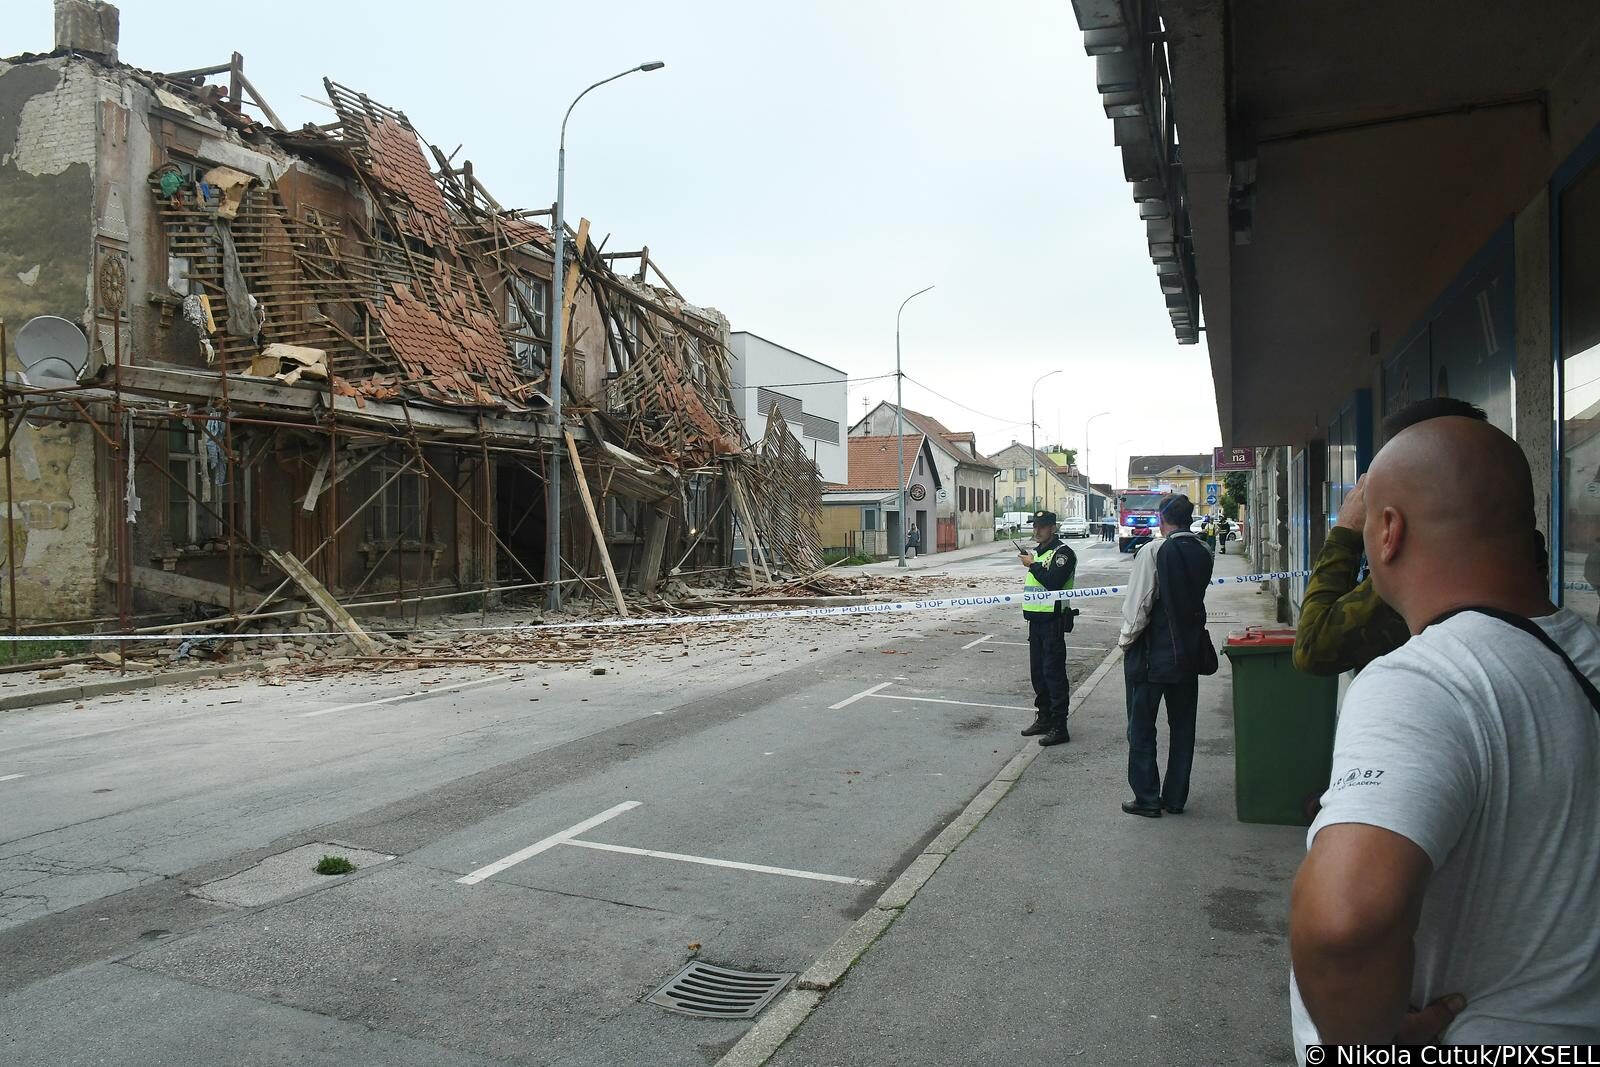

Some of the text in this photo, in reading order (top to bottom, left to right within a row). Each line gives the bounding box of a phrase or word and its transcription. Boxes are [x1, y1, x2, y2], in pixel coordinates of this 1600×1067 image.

[1236, 574, 1264, 583] STOP
[1024, 588, 1107, 601] STOP POLICIJA
[915, 596, 1000, 609] STOP POLICIJA
[842, 604, 892, 613] POLICIJA
